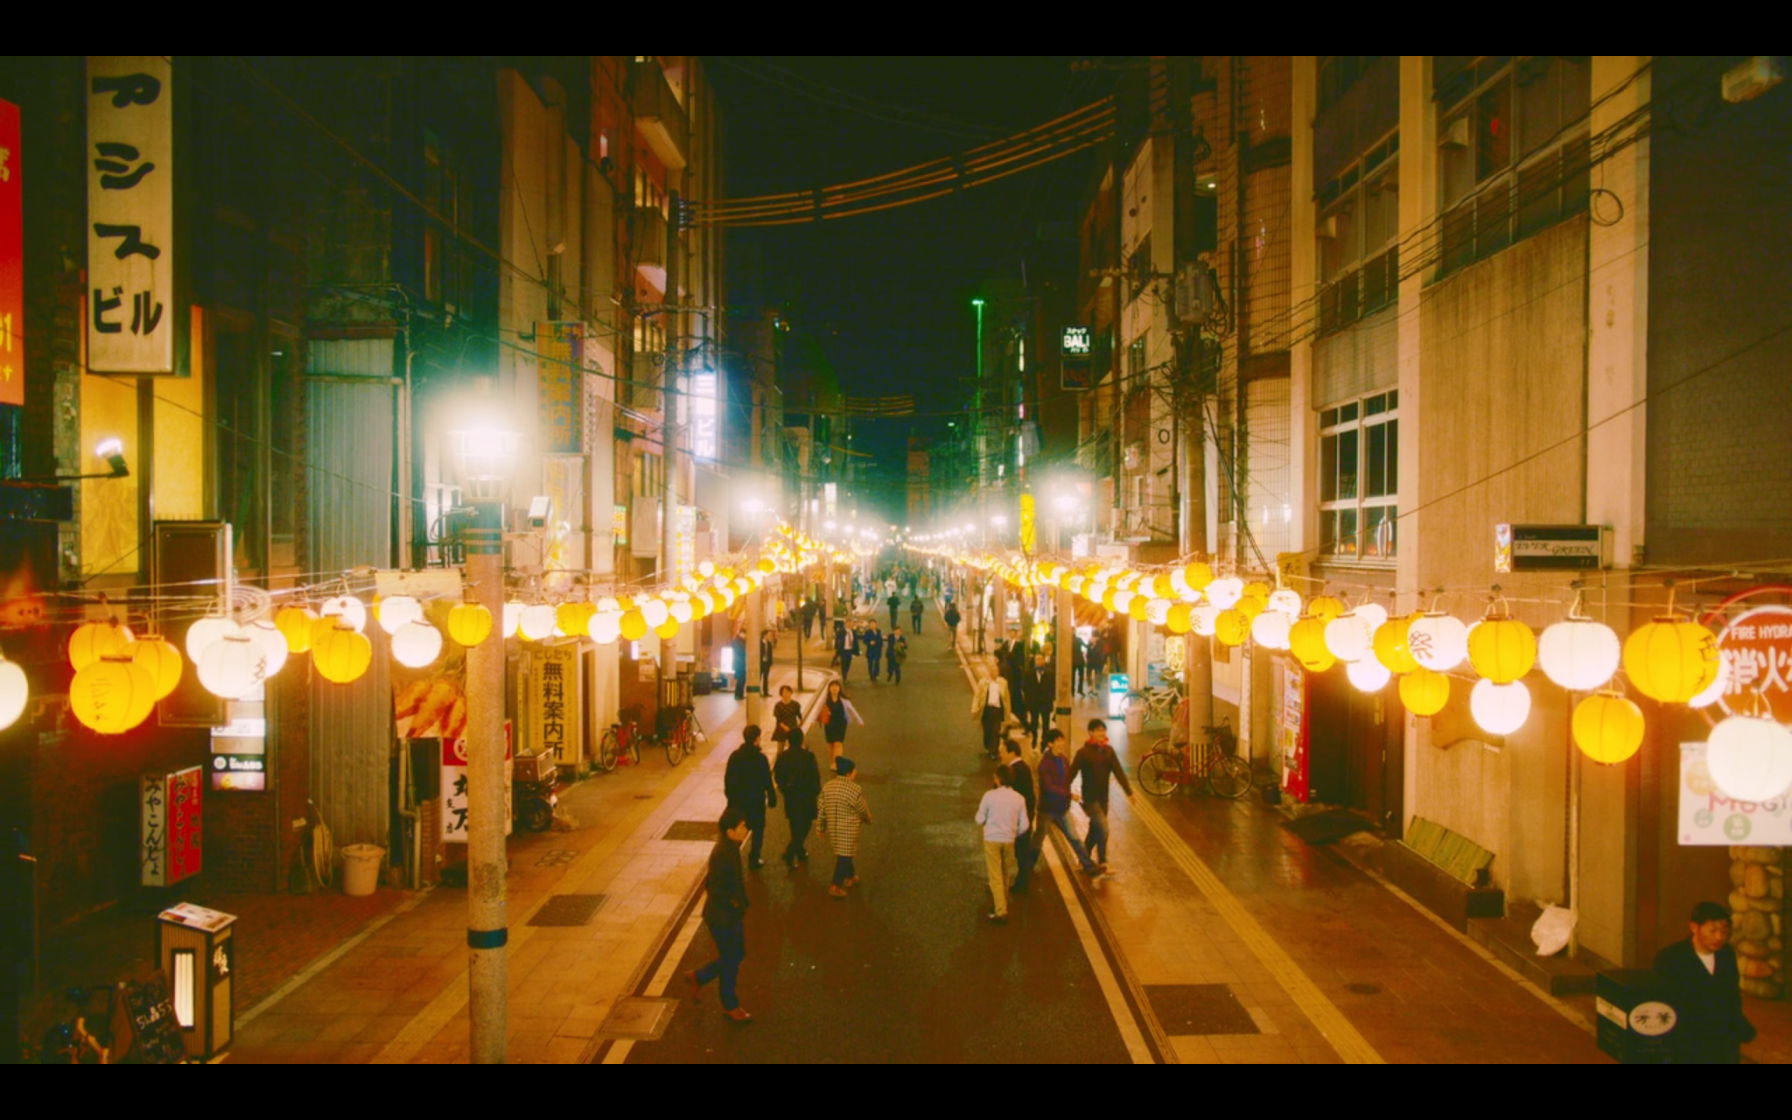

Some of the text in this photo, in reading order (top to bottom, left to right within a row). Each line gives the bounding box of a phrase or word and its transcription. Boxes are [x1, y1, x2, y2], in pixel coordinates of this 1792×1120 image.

[1063, 335, 1090, 348] BALI
[1515, 542, 1595, 555] EVER GREEN
[1731, 625, 1756, 641] FIRE
[1409, 631, 1434, 660] 祭
[1724, 646, 1792, 695] 消火
[543, 661, 564, 761] 無料案内所
